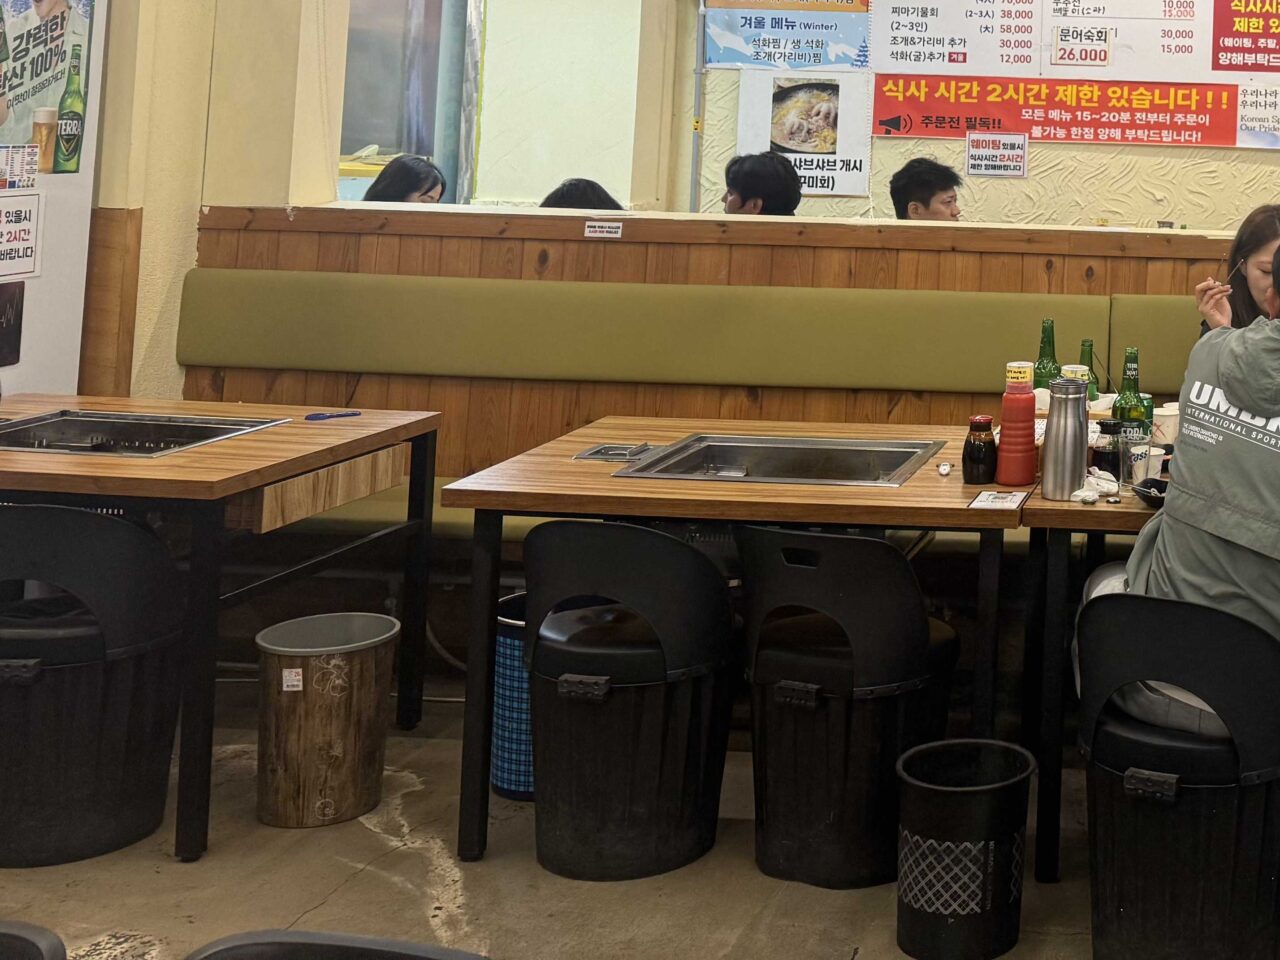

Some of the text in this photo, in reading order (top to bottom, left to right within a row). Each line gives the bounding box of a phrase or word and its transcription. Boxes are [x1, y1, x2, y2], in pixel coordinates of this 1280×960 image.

[1000, 10, 1033, 20] 38,000
[740, 16, 838, 31] 겨울 메뉴 (Winter)
[891, 22, 1032, 36] (2~3인) 58,000
[1233, 17, 1264, 32] 제한
[12, 10, 66, 63] 강력한
[1060, 28, 1107, 43] 문어숙회
[752, 39, 824, 49] 석화찜 생 석화
[890, 37, 1032, 50] 조개&가리비 추가 30,000
[30, 40, 66, 81] 100%
[753, 51, 822, 63] 조개(가리비)찜
[890, 52, 1031, 65] 석화(굴)추가 12,000
[1059, 48, 1107, 61] 26,000
[883, 80, 1199, 109] 식사 시간 2시간 제한 있습니다
[1240, 89, 1278, 99] 우리나라
[1240, 100, 1278, 109] 우리나라
[920, 116, 1001, 130] 주문전 필독!!
[1021, 109, 1210, 126] 모든 메뉴 15~20분 전부터 주문이
[1240, 115, 1269, 123] Korean
[1031, 126, 1202, 142] 불가능 한점 양해 부탁드립니다!
[1259, 125, 1280, 133] Pride
[971, 139, 1001, 150] 웨이팅
[794, 158, 862, 172] 샤브샤브 개시
[5, 209, 31, 224] 있을시
[6, 229, 30, 243] 2시간
[1185, 407, 1246, 434] INTERNATIONAL
